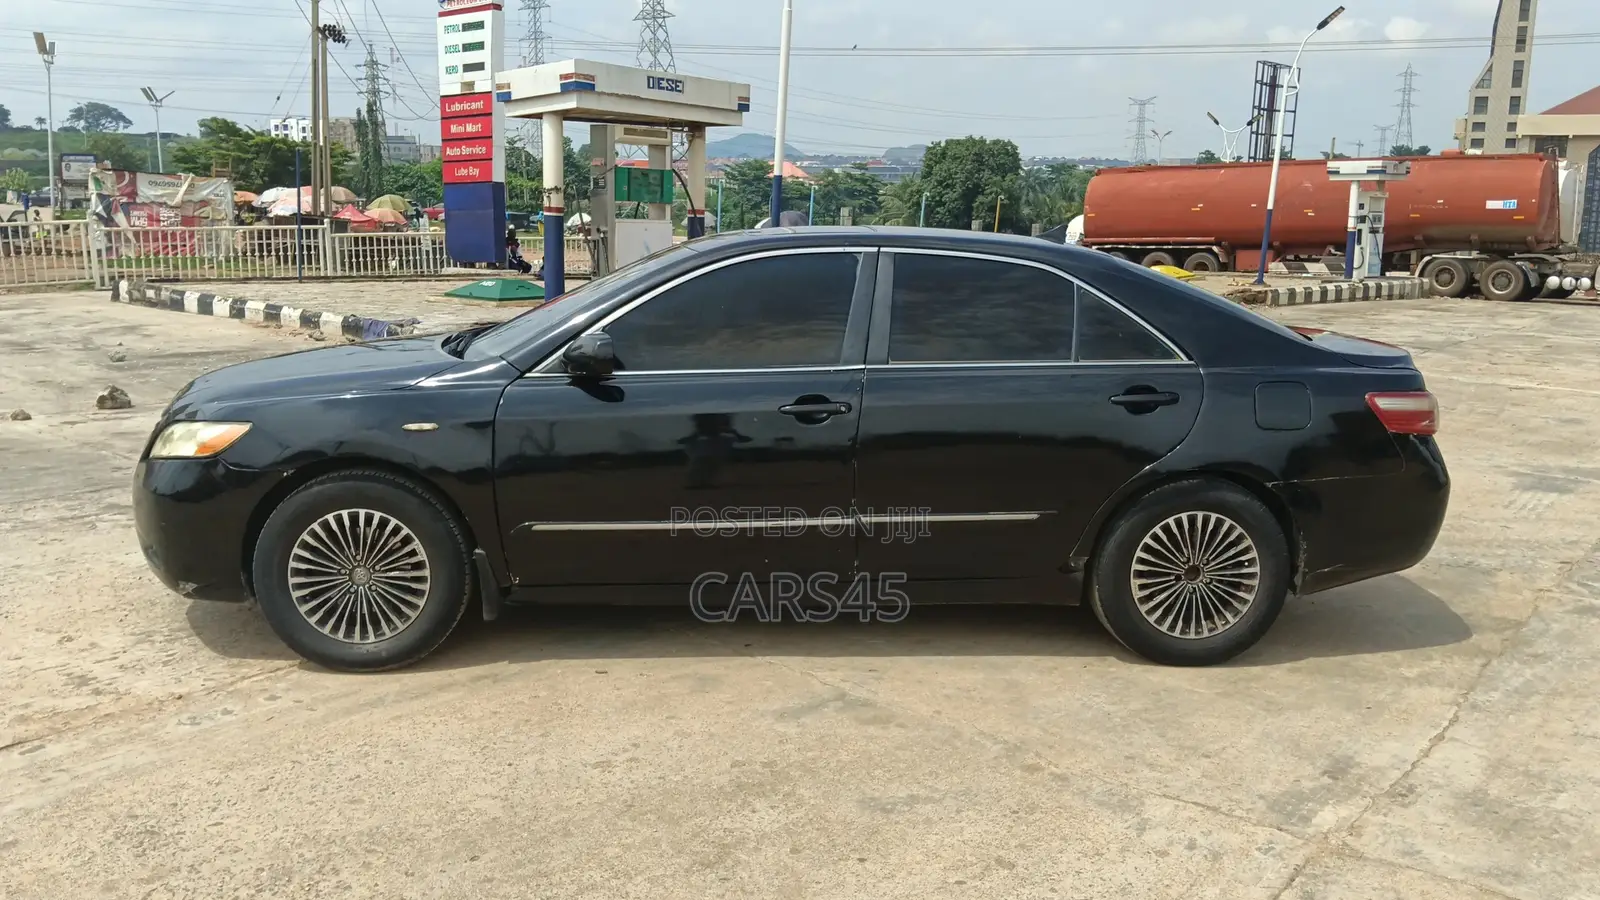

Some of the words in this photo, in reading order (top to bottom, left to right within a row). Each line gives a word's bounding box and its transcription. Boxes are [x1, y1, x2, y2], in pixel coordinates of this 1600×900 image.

[444, 24, 461, 34] PETROL
[444, 44, 461, 54] DIESEL
[445, 65, 459, 75] KERO
[647, 76, 685, 94] DIESE
[445, 100, 484, 112] Lubricant
[450, 123, 465, 134] Mini
[466, 122, 482, 132] Mart
[446, 146, 461, 156] Auto
[461, 144, 487, 155] Service
[454, 166, 468, 176] Lube
[468, 166, 480, 178] Bay
